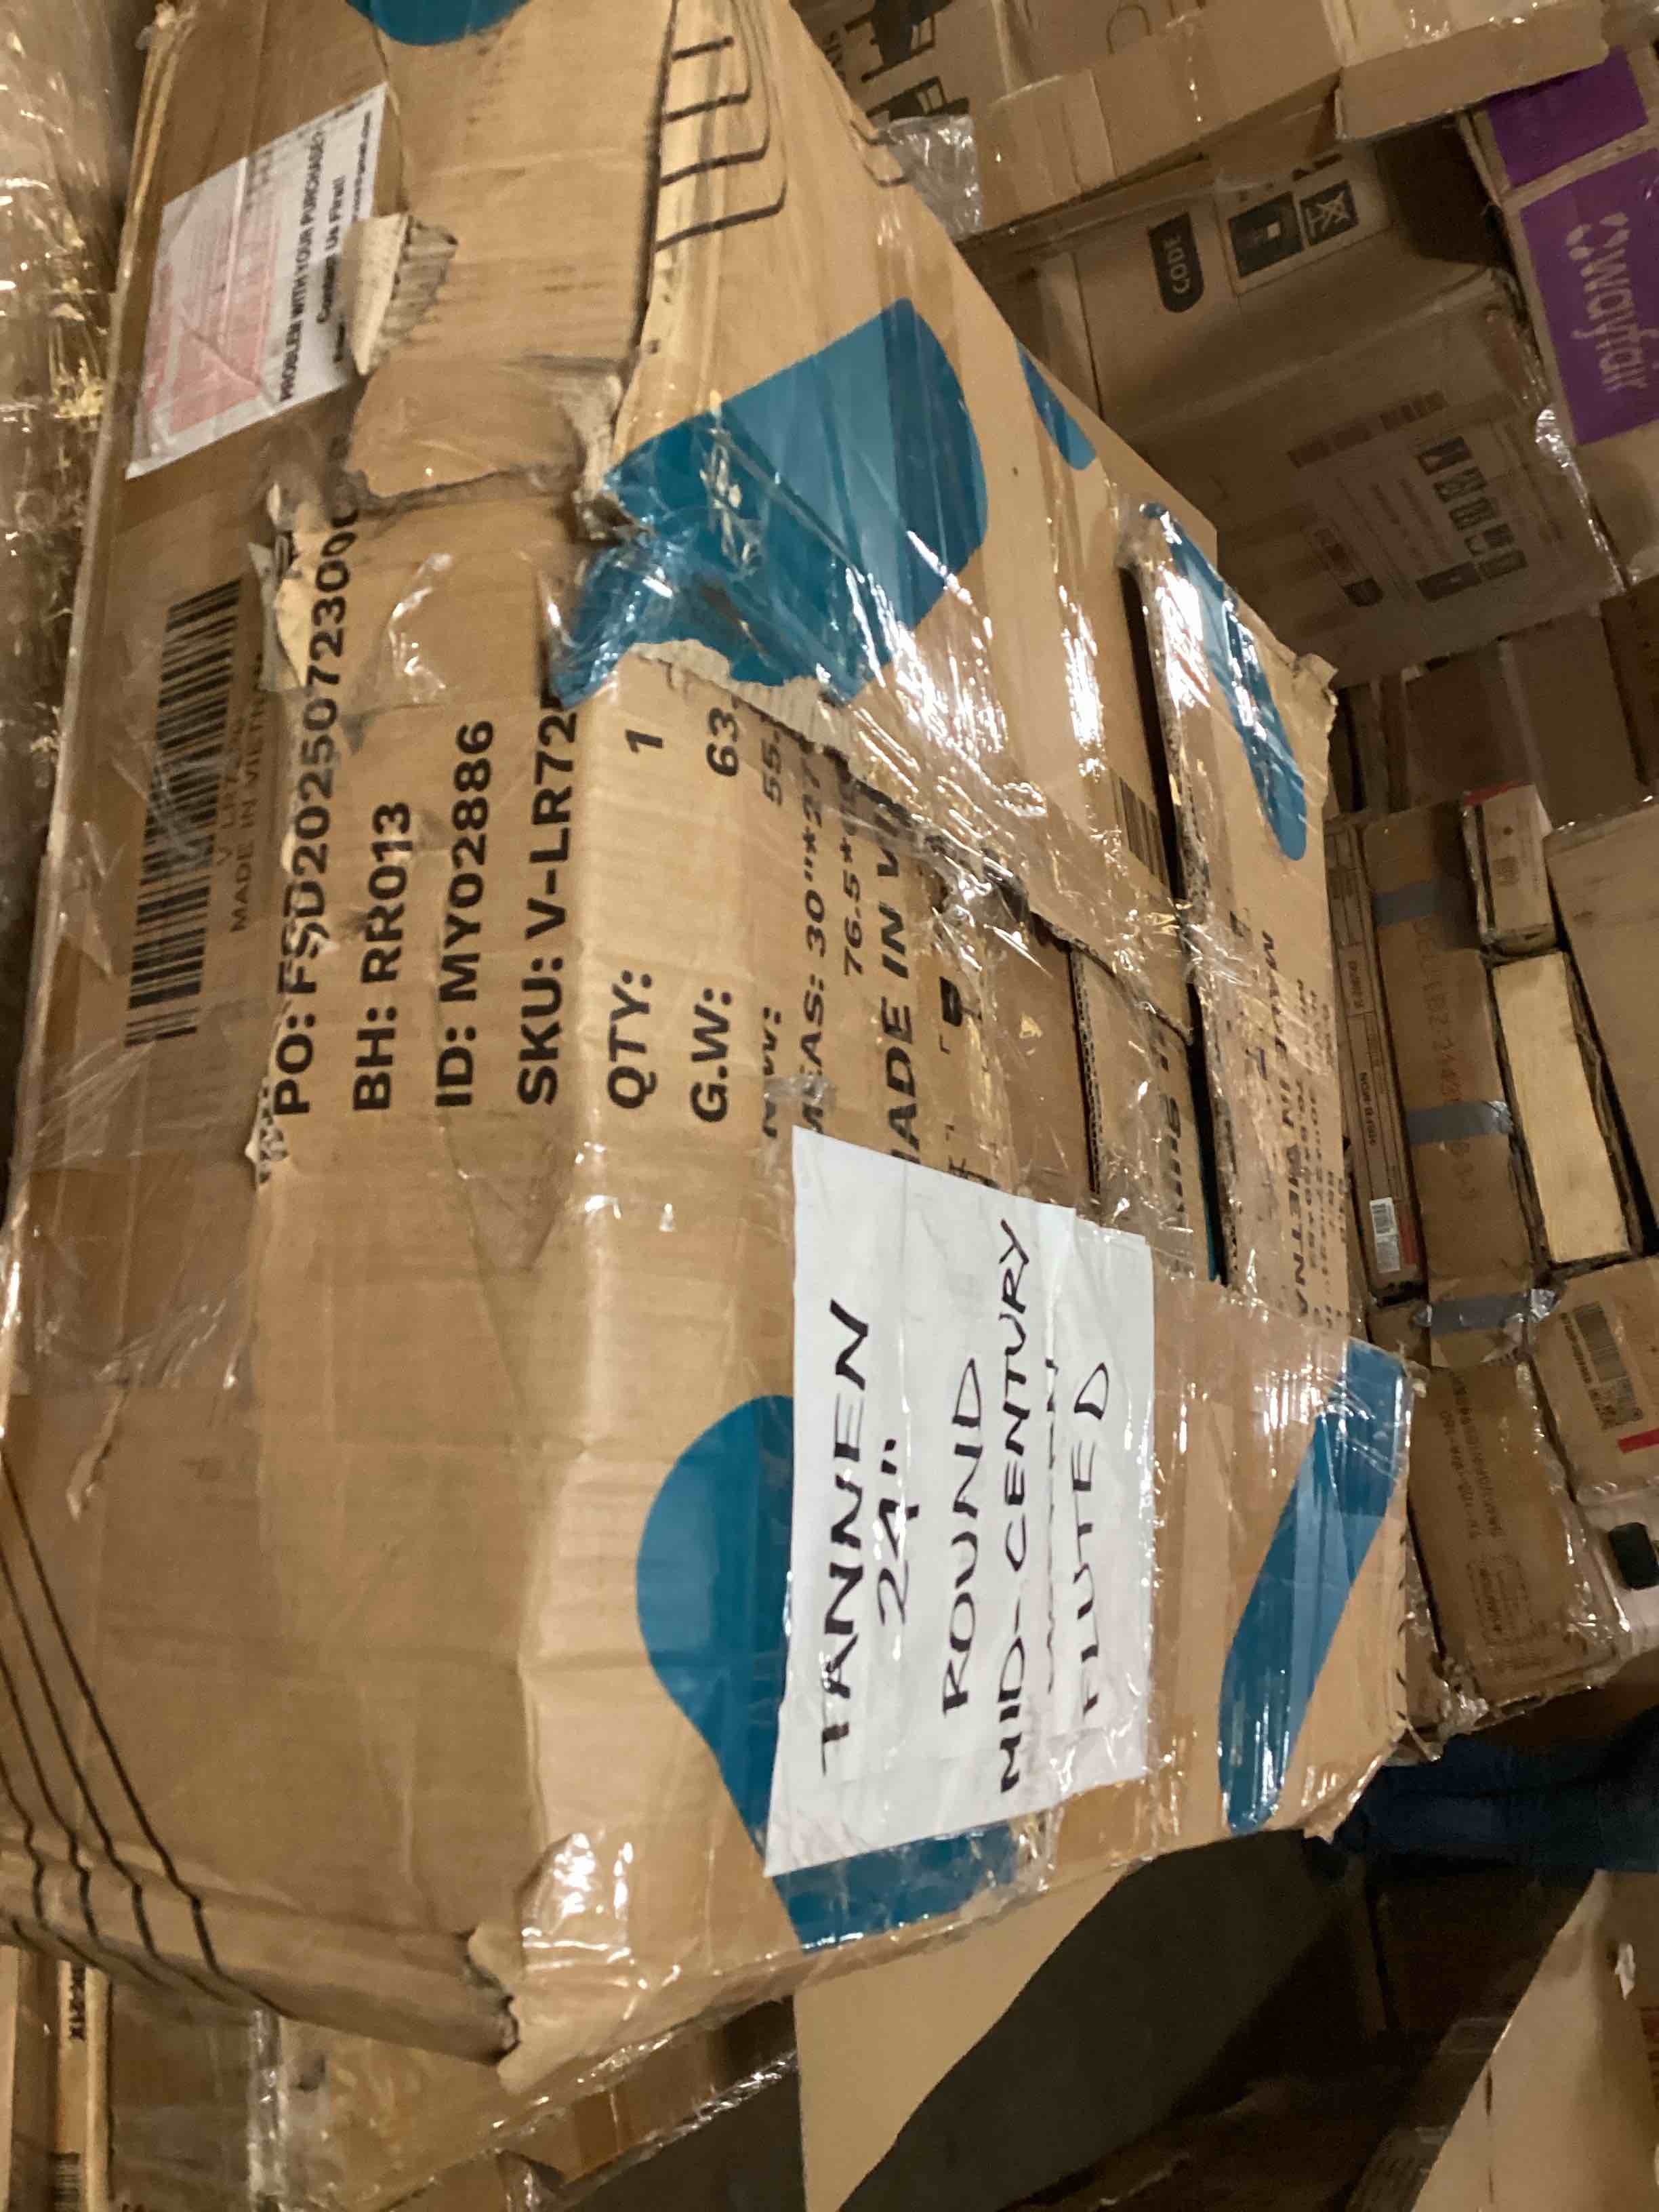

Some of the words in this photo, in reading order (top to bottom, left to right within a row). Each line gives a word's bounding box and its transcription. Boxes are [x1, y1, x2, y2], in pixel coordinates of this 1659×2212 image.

[299, 130, 325, 226] PURCHASE?
[293, 227, 314, 273] YOUR
[324, 226, 340, 250] Us
[1162, 236, 1191, 294] CODE
[289, 275, 309, 320] WITH
[315, 253, 340, 324] Contact
[279, 321, 304, 403] PROBLEM
[625, 729, 664, 755] 1
[239, 799, 259, 829] IN
[438, 720, 495, 1002] MY02886
[230, 841, 255, 933] MADE
[359, 802, 414, 984] RR013
[878, 901, 909, 979] IN
[272, 1013, 317, 1116] PO:
[352, 1007, 398, 1111] BH:
[434, 1026, 478, 1107] ID:
[517, 957, 565, 1106] SKU:
[606, 969, 658, 1110] QTY:
[689, 987, 733, 1124] G.W:
[1278, 1080, 1294, 1128] IN
[819, 1298, 870, 1775] TANNEN
[874, 1437, 922, 1625] 24"
[941, 1357, 984, 1717] ROUND
[1068, 1361, 1110, 1719] FLUTED
